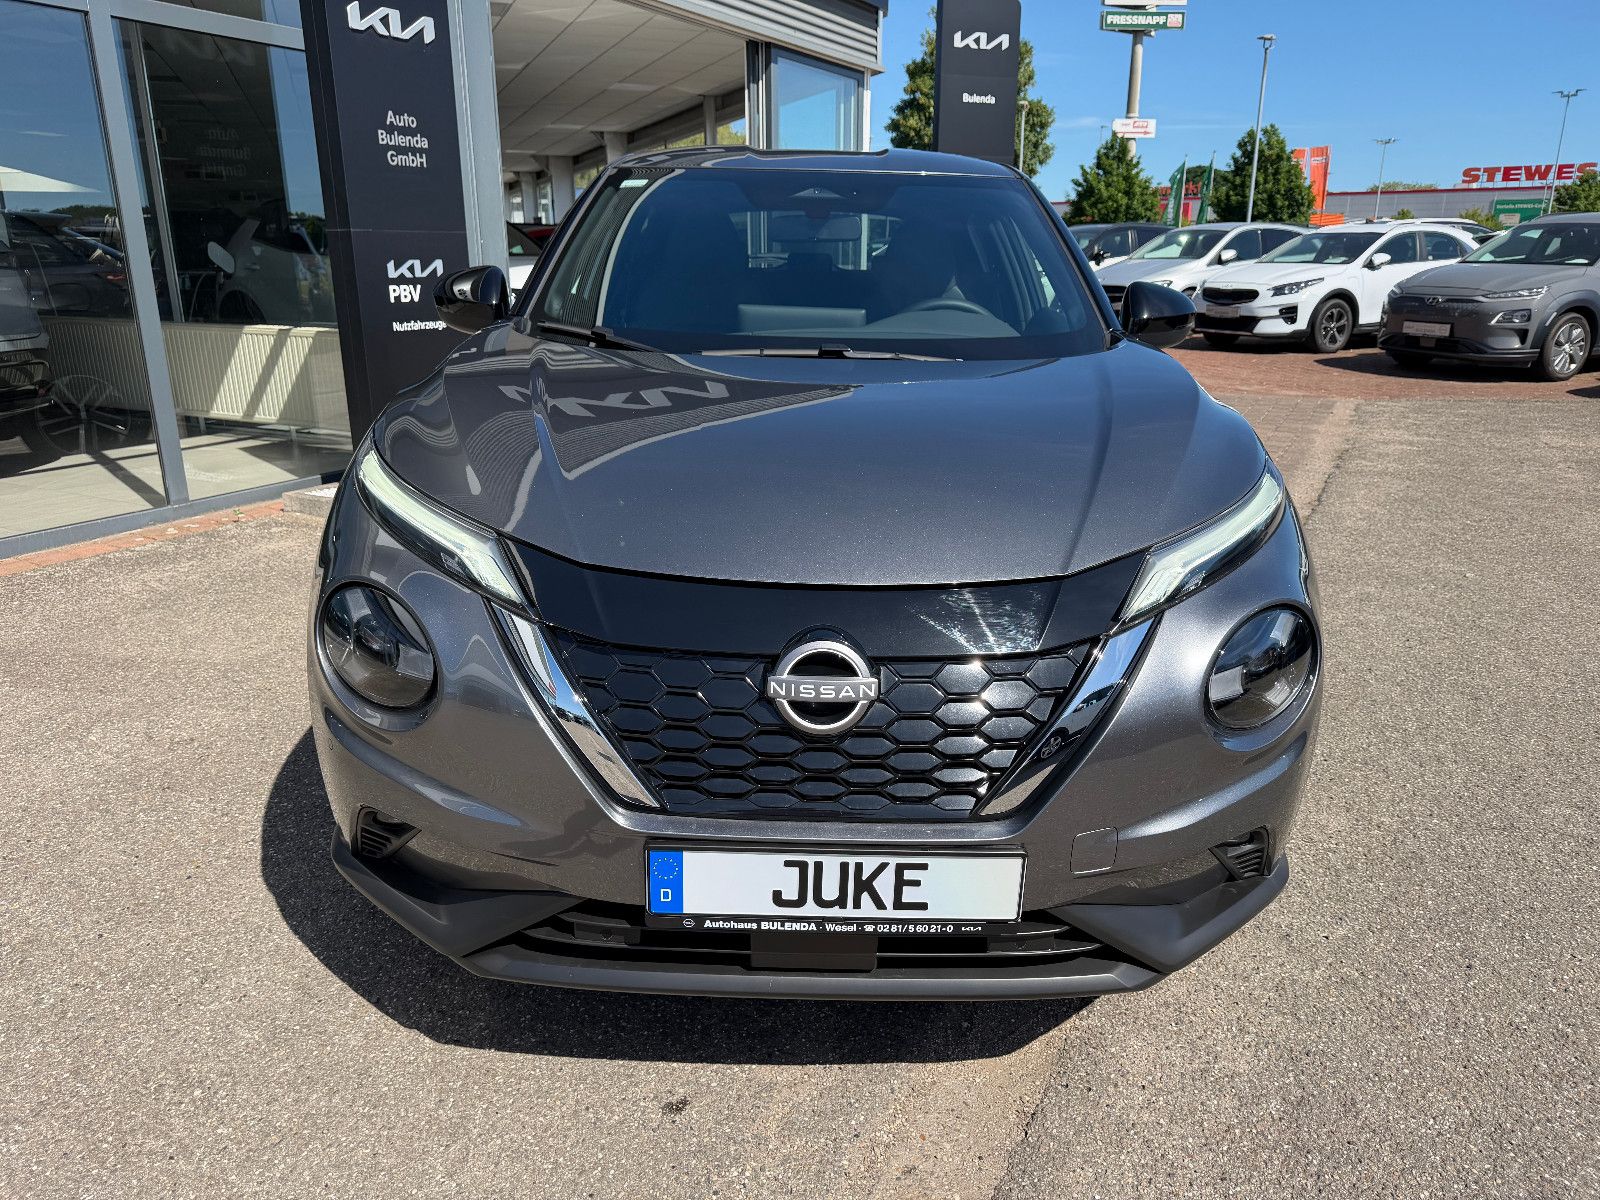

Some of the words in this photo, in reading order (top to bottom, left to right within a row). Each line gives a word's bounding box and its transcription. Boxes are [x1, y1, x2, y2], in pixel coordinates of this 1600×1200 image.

[346, 0, 436, 44] KIA
[1106, 14, 1166, 25] FRESSNAPF
[953, 30, 1010, 51] KIA
[962, 92, 996, 104] Bulenda
[386, 110, 417, 128] Auto
[378, 129, 429, 148] Bulenda
[387, 150, 427, 168] GmbH
[1461, 162, 1598, 184] STEWES
[386, 258, 444, 278] KIA
[388, 284, 422, 304] PBV
[770, 681, 877, 699] NISSAN
[772, 859, 929, 911] JUKE
[660, 888, 672, 902] D
[703, 920, 758, 930] Autohaus
[760, 921, 818, 931] BULENDA
[825, 923, 857, 932] Wesel
